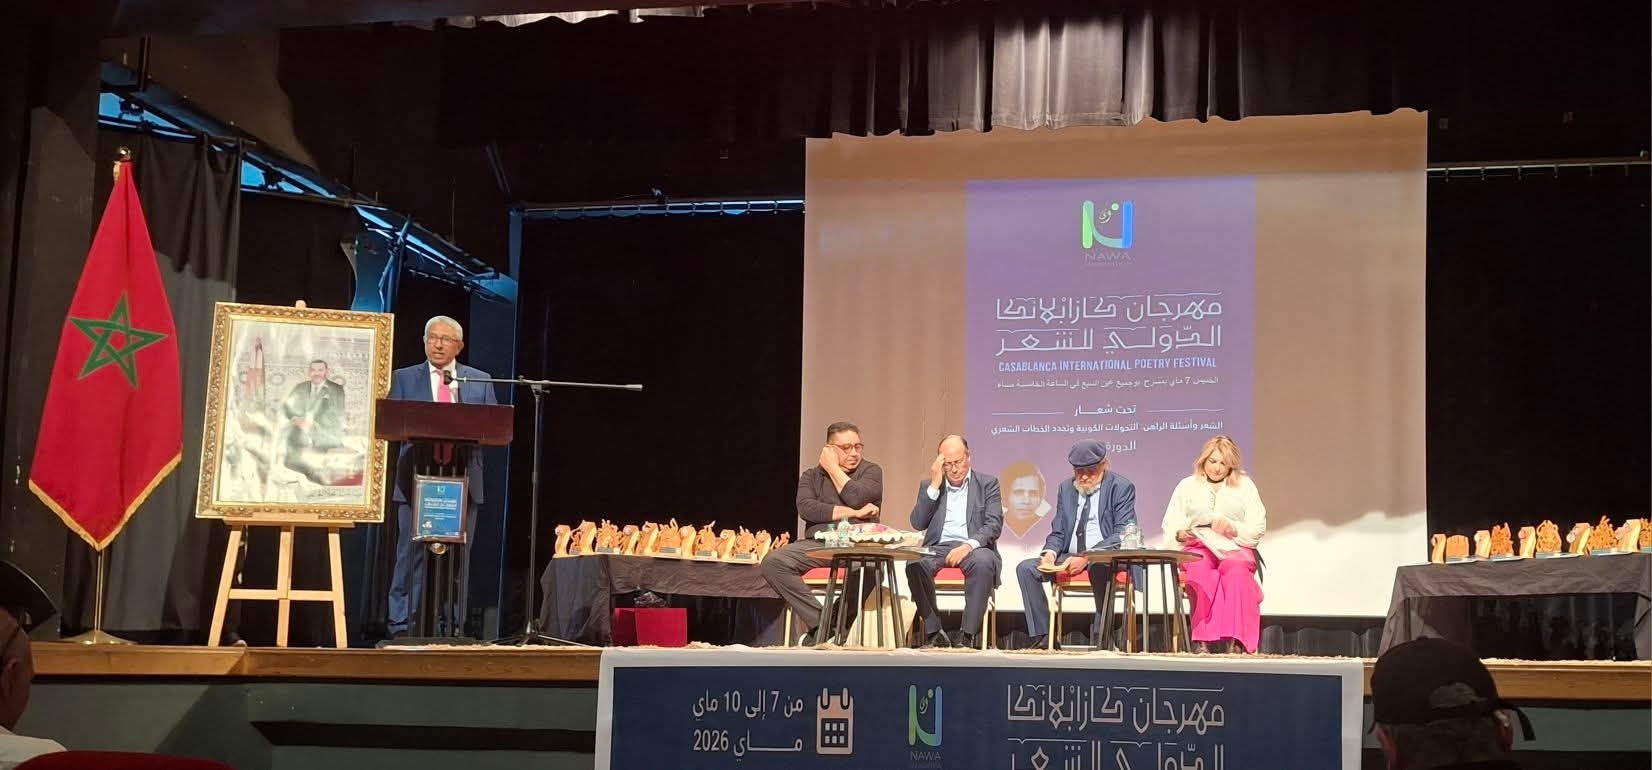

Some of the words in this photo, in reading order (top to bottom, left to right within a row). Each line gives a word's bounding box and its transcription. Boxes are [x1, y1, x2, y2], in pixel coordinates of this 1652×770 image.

[1127, 292, 1222, 322] مهرجان
[996, 327, 1094, 357] للشعر
[999, 361, 1058, 372] CASABLANCA
[1059, 359, 1132, 371] INTERNATIONAL
[1134, 358, 1171, 369] POETRY
[1173, 356, 1217, 368] FESTIVAL
[1184, 376, 1192, 385] 7
[1115, 404, 1137, 415] تحت
[991, 424, 1020, 437] الشعري
[1076, 422, 1103, 434] الكونية
[1200, 419, 1223, 431] الشعر
[1105, 440, 1137, 453] الدورة
[692, 688, 719, 721] ماي
[724, 690, 741, 713] 10
[744, 688, 766, 720] إلى
[771, 690, 780, 713] 7
[784, 695, 803, 718] من
[1131, 686, 1225, 735] مهرجان
[693, 729, 729, 751] 2026
[910, 751, 942, 761] NAWA
